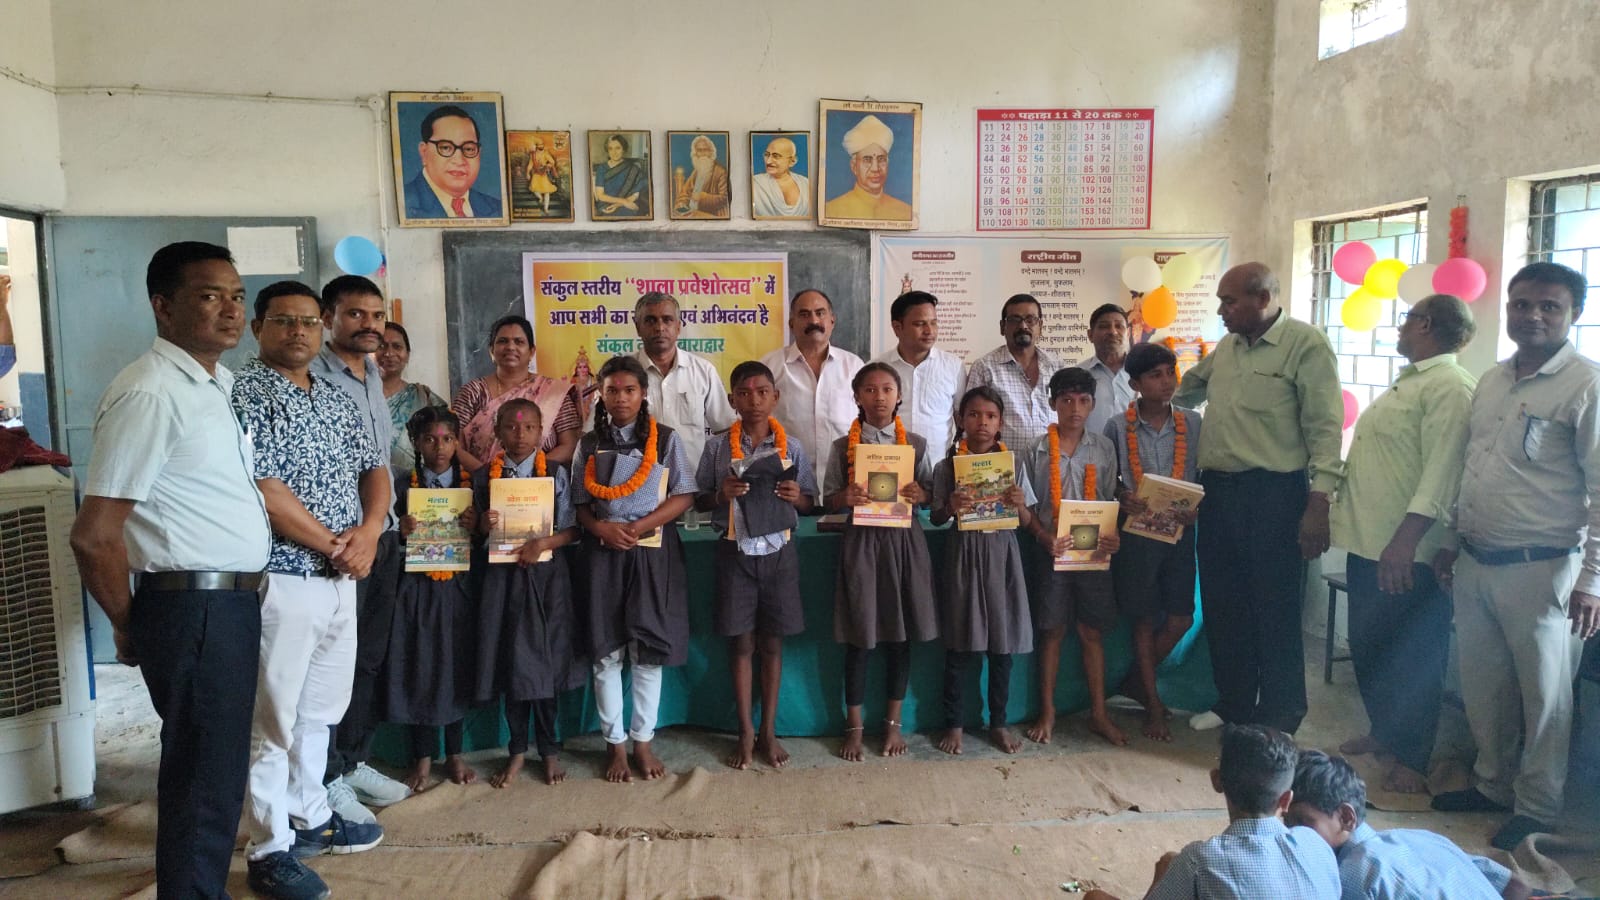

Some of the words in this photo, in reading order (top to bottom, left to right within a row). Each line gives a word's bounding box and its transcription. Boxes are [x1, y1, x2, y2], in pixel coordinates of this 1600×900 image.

[1072, 110, 1080, 119] से
[1057, 252, 1077, 261] गीत
[541, 275, 578, 301] संकुल
[582, 275, 621, 296] स्तरीय
[764, 274, 776, 295] में
[550, 309, 576, 325] आप
[579, 304, 607, 325] सभी
[610, 310, 628, 324] का
[680, 305, 697, 327] एवं
[700, 304, 756, 324] अभिनंदन
[760, 304, 769, 326] है
[596, 334, 634, 355] संकुल
[677, 338, 725, 353] बाराद्वार
